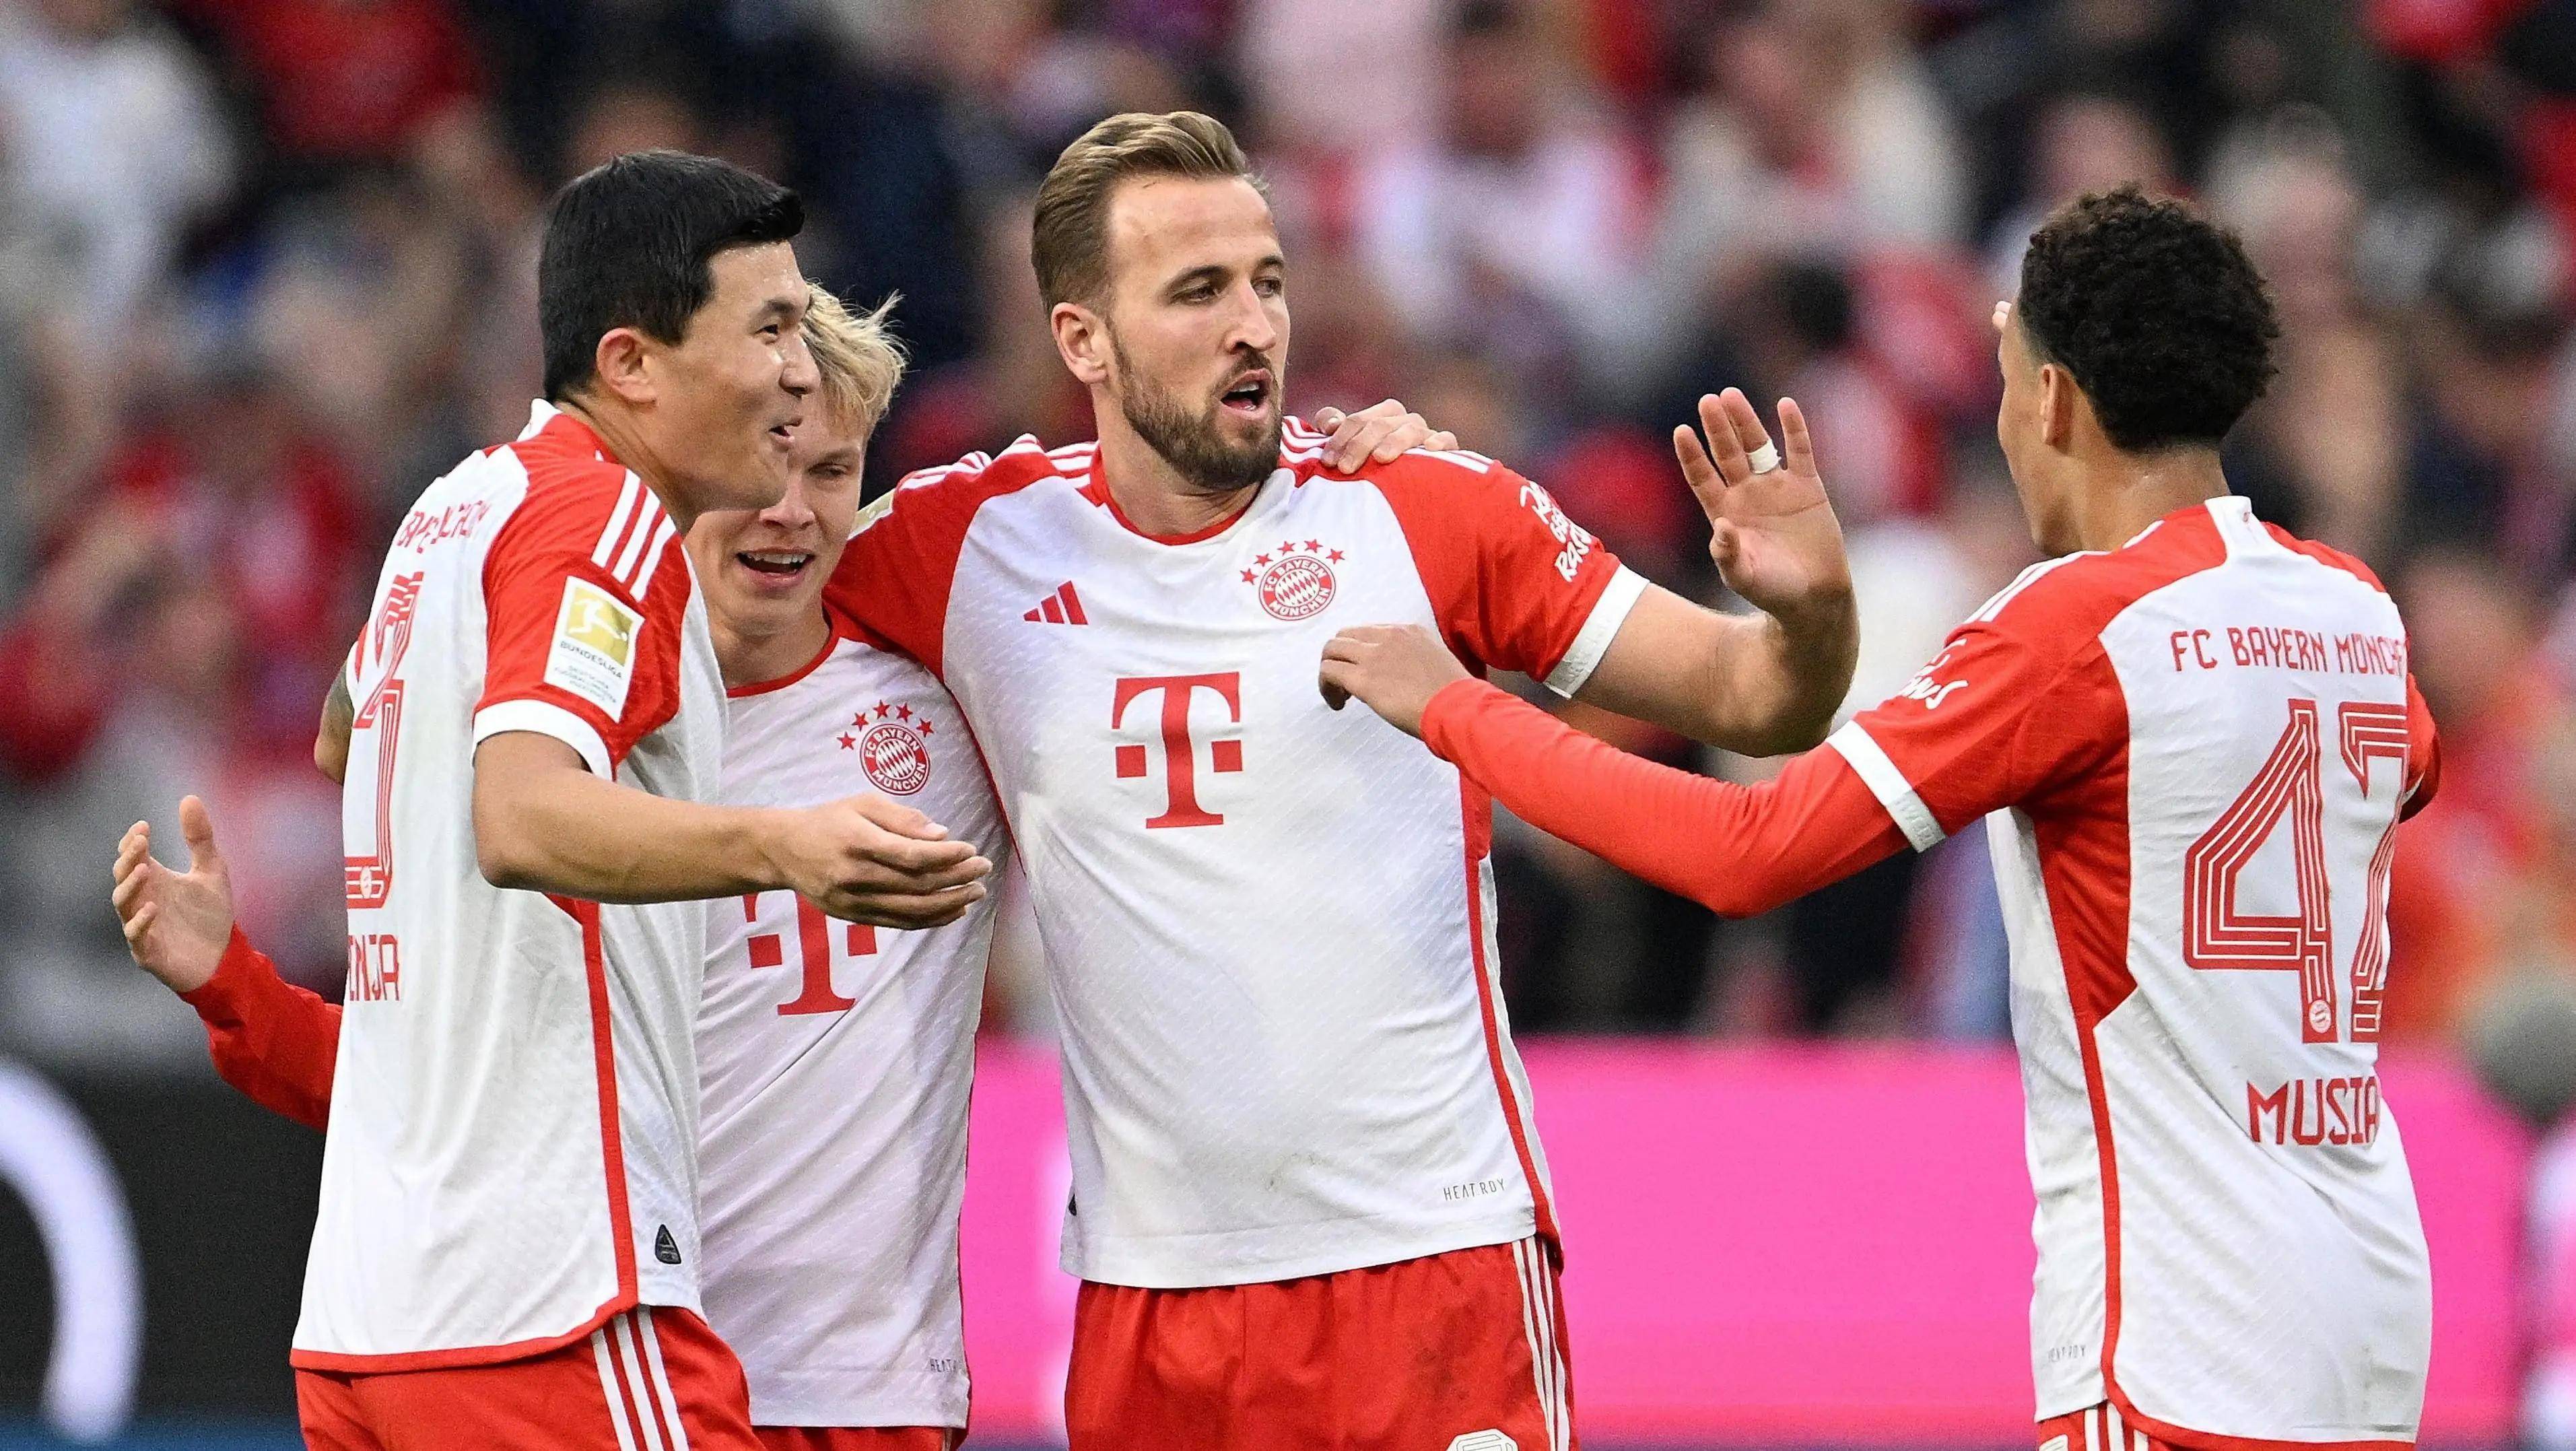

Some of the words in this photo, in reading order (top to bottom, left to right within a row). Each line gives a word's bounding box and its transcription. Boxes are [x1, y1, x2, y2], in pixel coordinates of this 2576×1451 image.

[1264, 575, 1279, 592] FC
[1275, 559, 1327, 578] BAYERN
[560, 640, 622, 678] BUNDESLIGA
[2171, 630, 2218, 672] FC
[2227, 626, 2328, 673] BAYERN
[865, 741, 877, 758] FC
[874, 728, 920, 751] BAYERN
[1112, 671, 1240, 829] T
[2247, 1076, 2380, 1145] MUSIA
